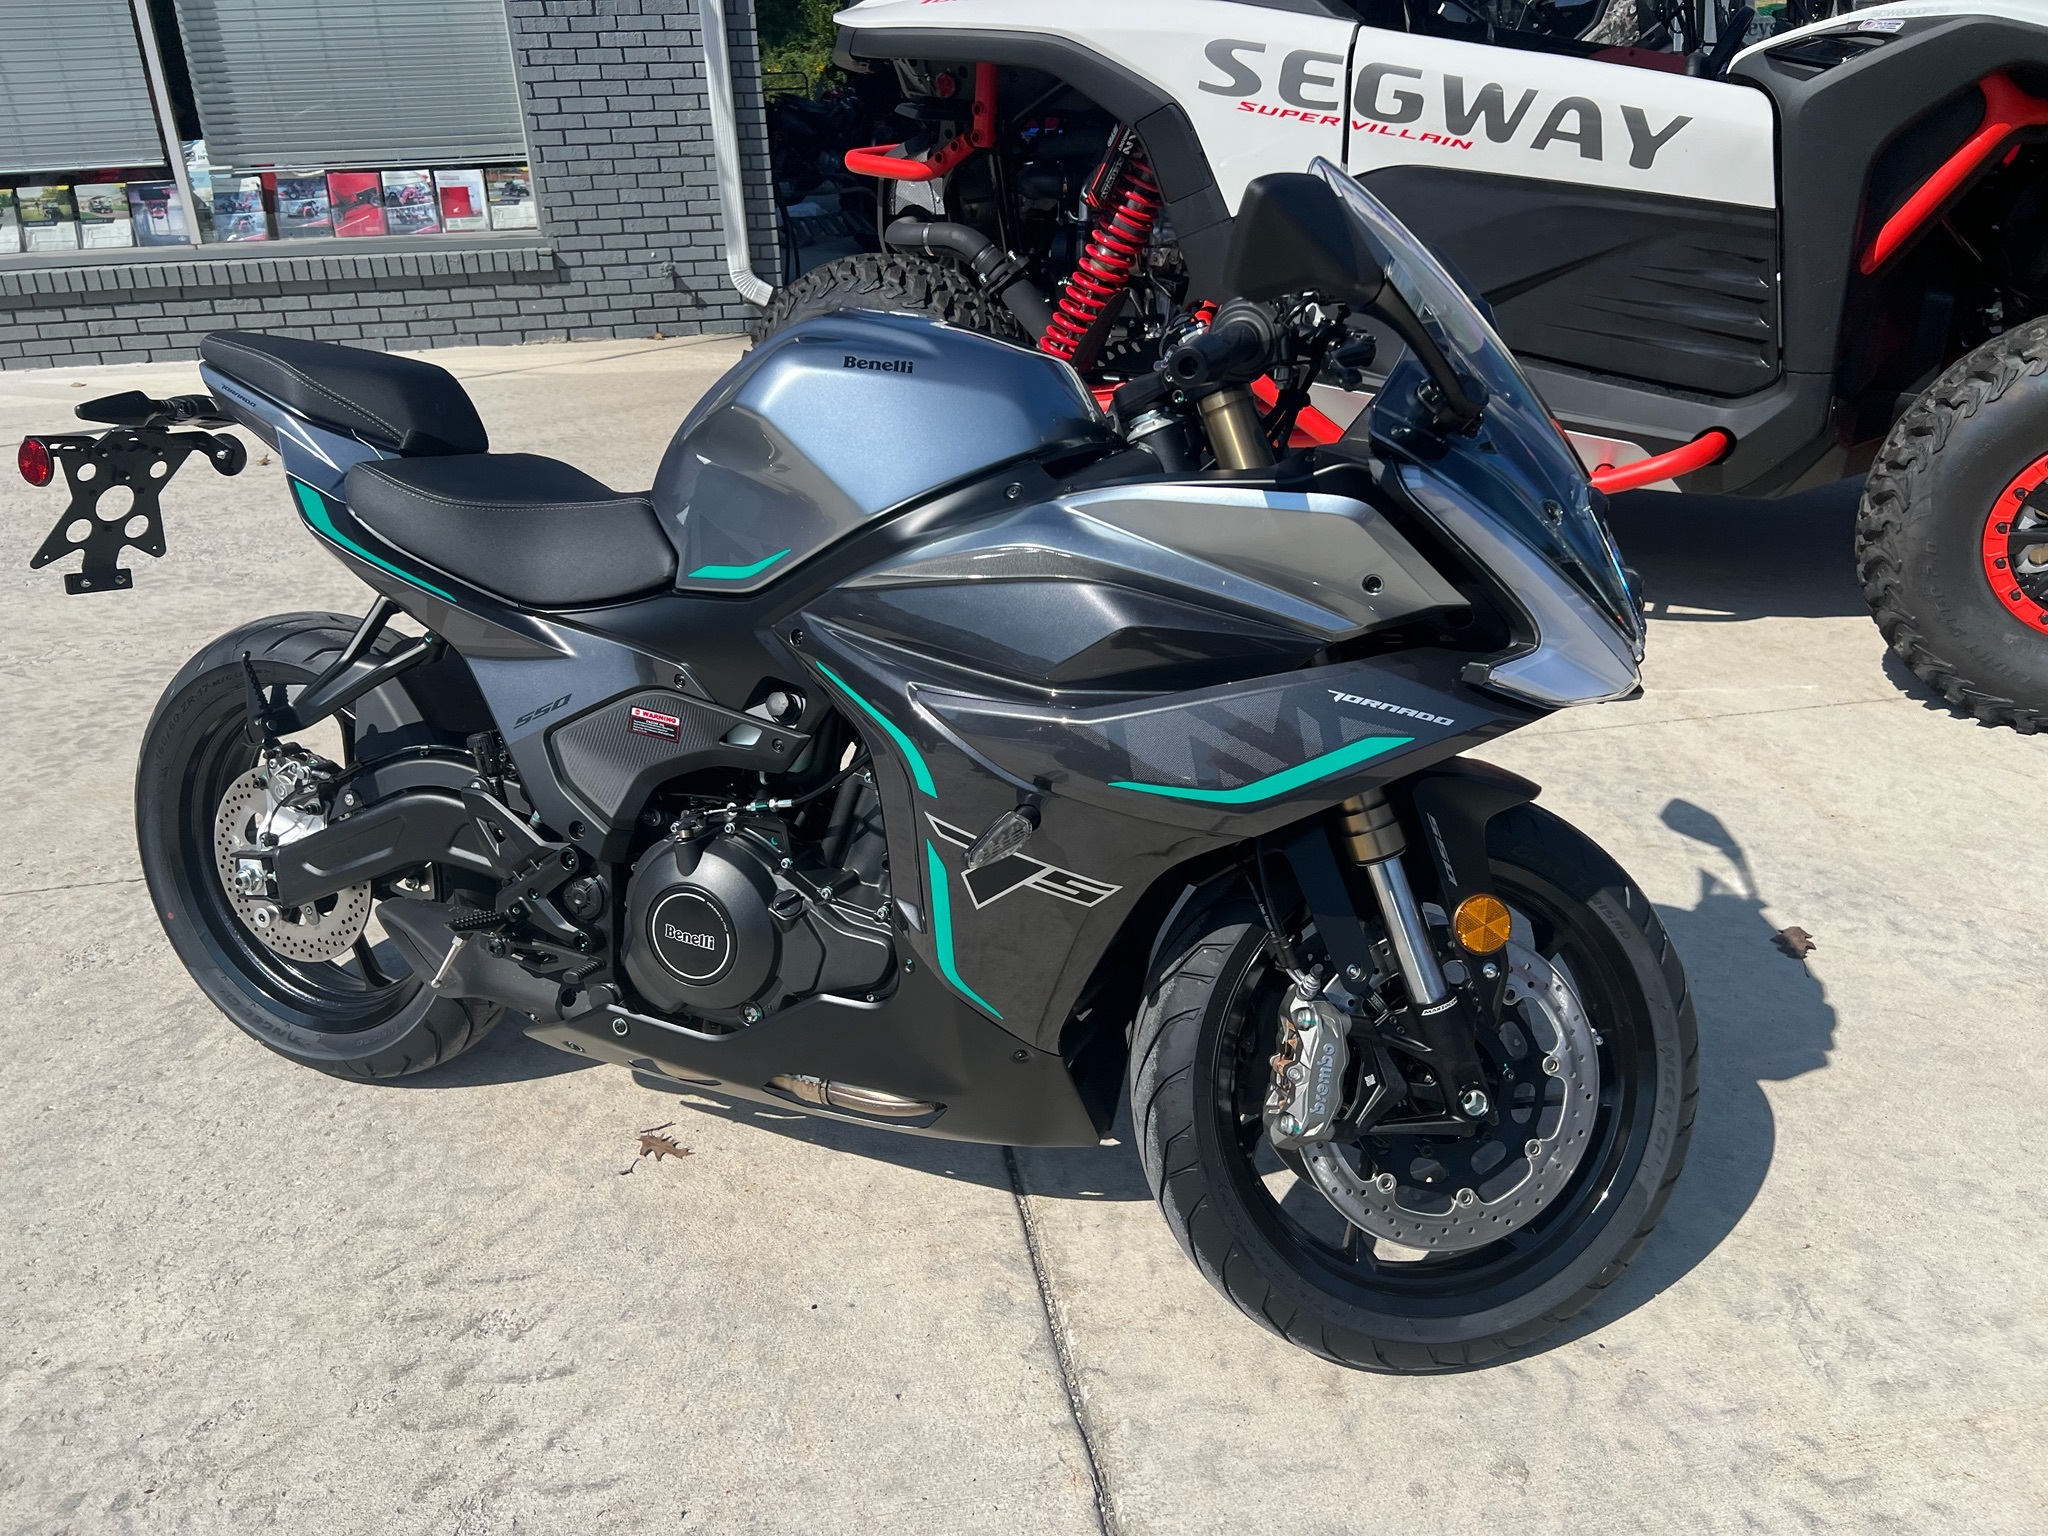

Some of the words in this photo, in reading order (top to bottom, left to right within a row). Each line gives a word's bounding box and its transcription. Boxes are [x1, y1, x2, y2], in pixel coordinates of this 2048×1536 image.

[1198, 38, 1694, 170] SEGWAY
[1237, 101, 1341, 128] SUPER
[1351, 120, 1475, 151] VILLAIN
[843, 355, 914, 374] Benelli
[221, 383, 257, 408] TORNADO
[513, 692, 573, 730] 550
[642, 711, 676, 723] WARNING
[1327, 689, 1455, 727] TORNADO
[1426, 812, 1459, 887] 550
[664, 923, 715, 951] Benelli
[1309, 1043, 1335, 1115] brembo
